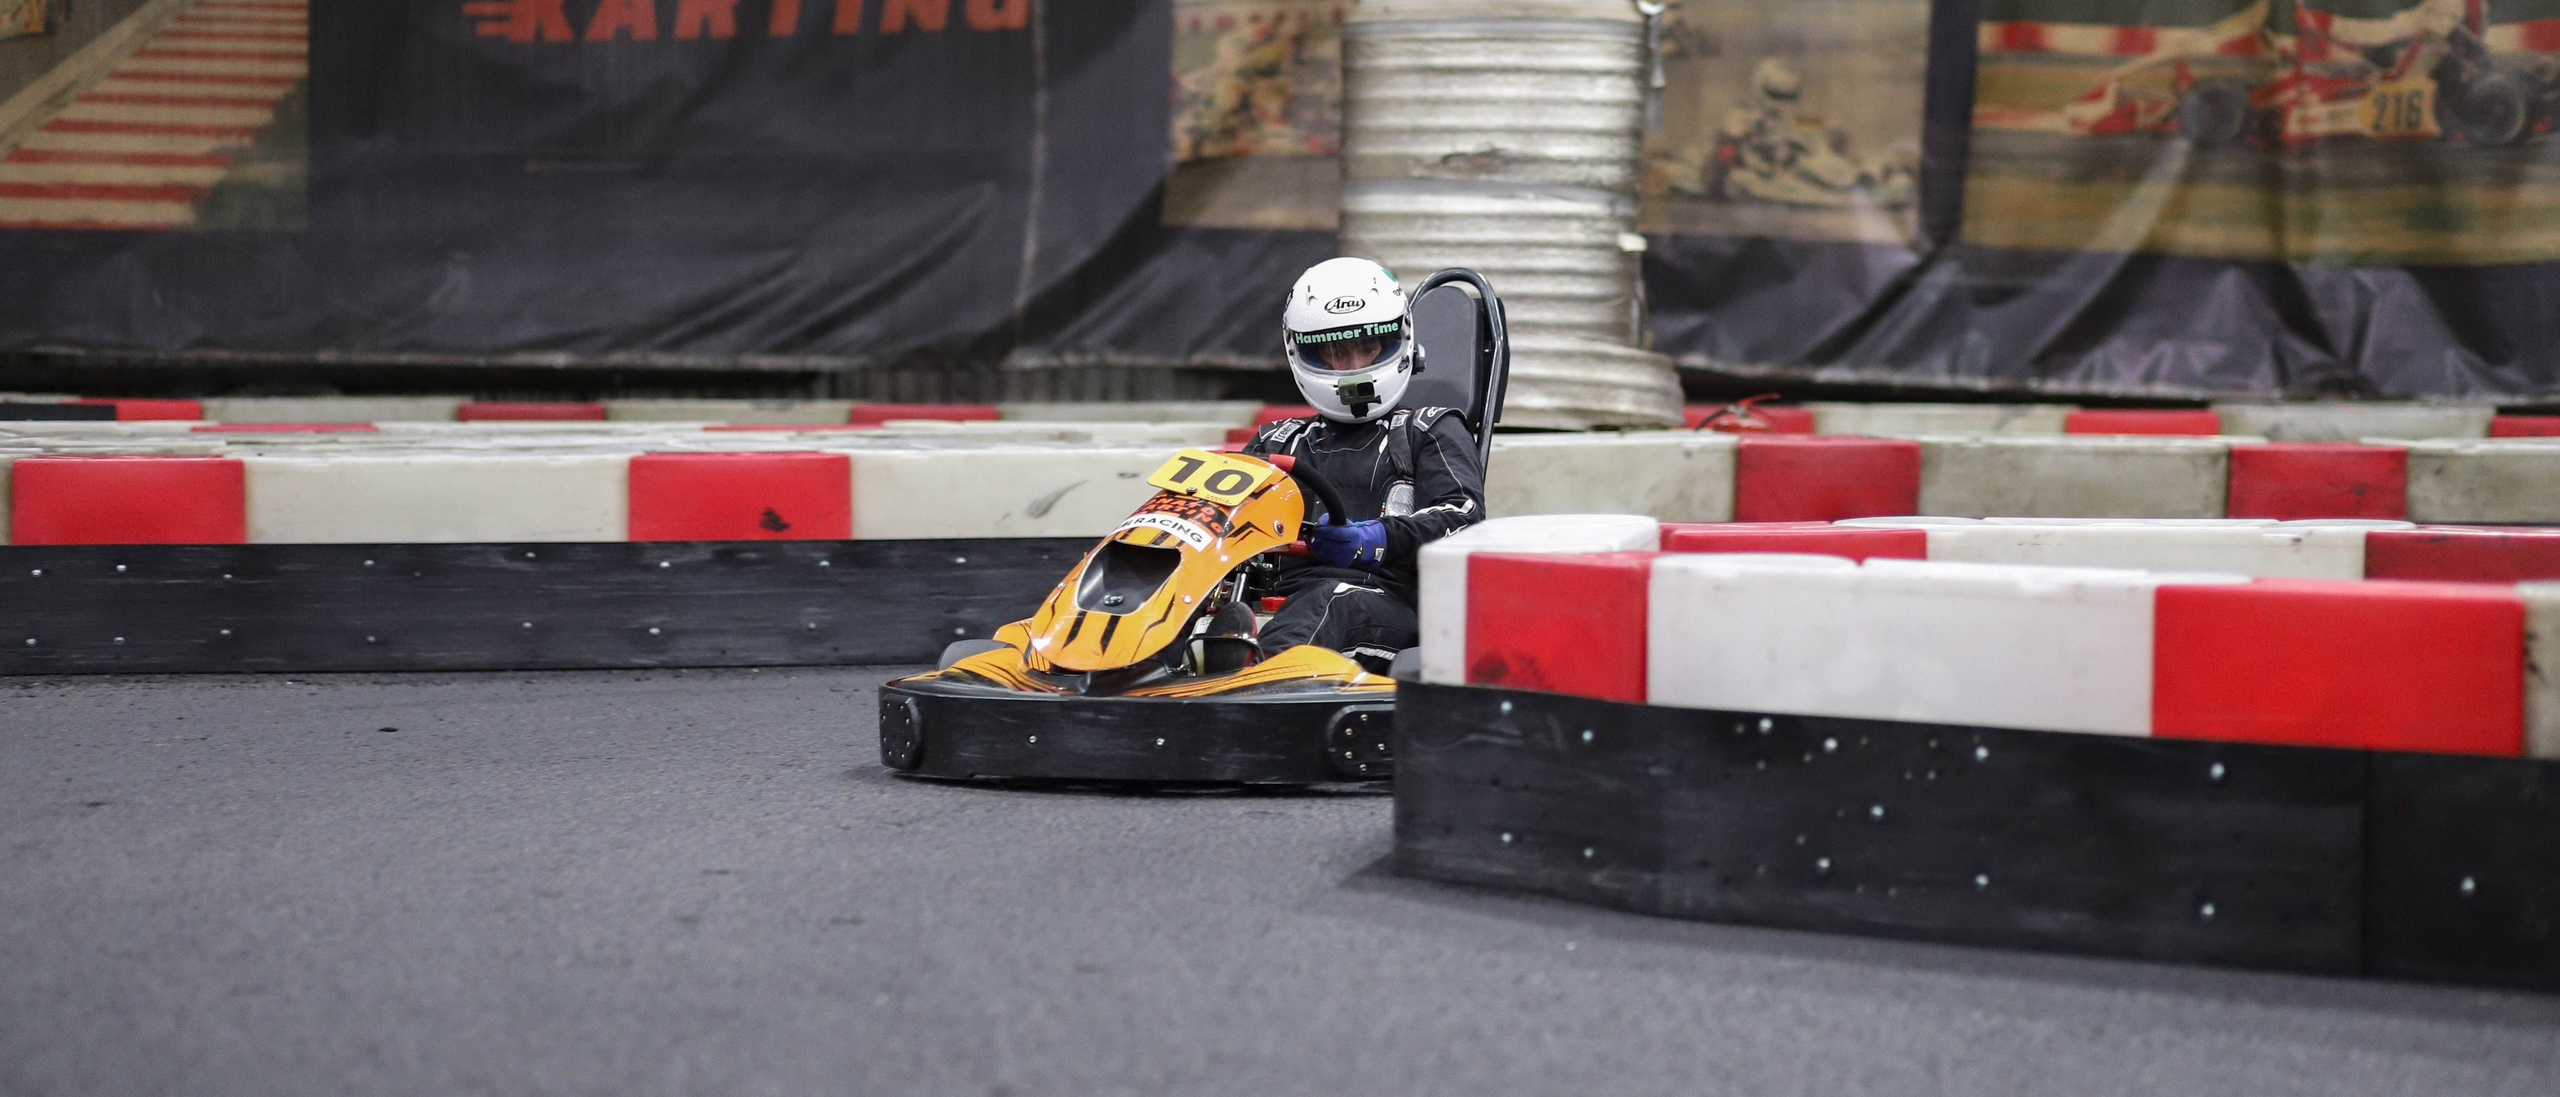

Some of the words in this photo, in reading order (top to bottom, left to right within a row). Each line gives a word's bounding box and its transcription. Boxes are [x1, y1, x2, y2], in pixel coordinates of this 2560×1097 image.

[1327, 298, 1360, 310] Arai
[1295, 328, 1361, 344] Hammer
[1363, 322, 1399, 336] Time
[1169, 456, 1254, 495] 10
